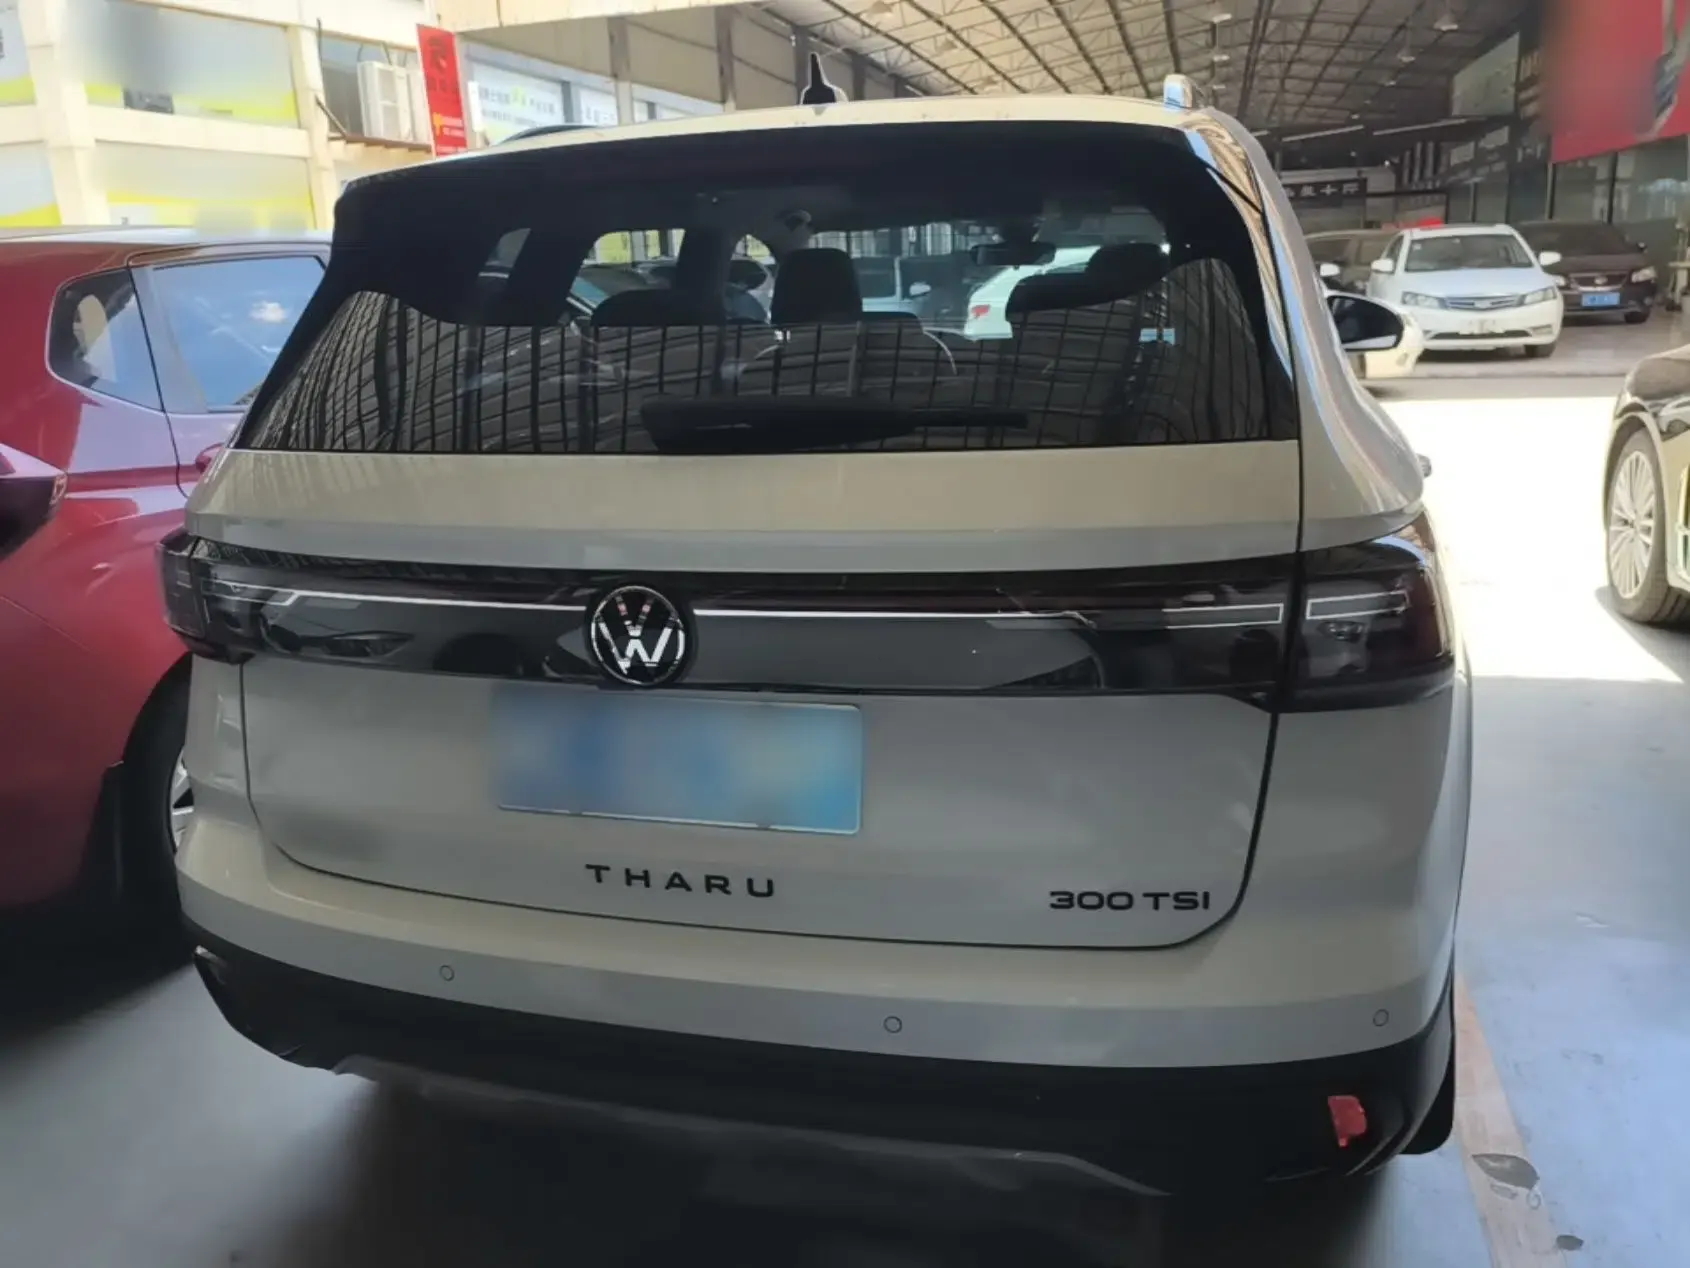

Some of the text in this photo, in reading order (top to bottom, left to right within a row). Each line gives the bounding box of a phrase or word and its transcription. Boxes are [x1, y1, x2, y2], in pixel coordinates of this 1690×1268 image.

[585, 863, 775, 898] THARU
[1049, 890, 1210, 911] 300 TSI
